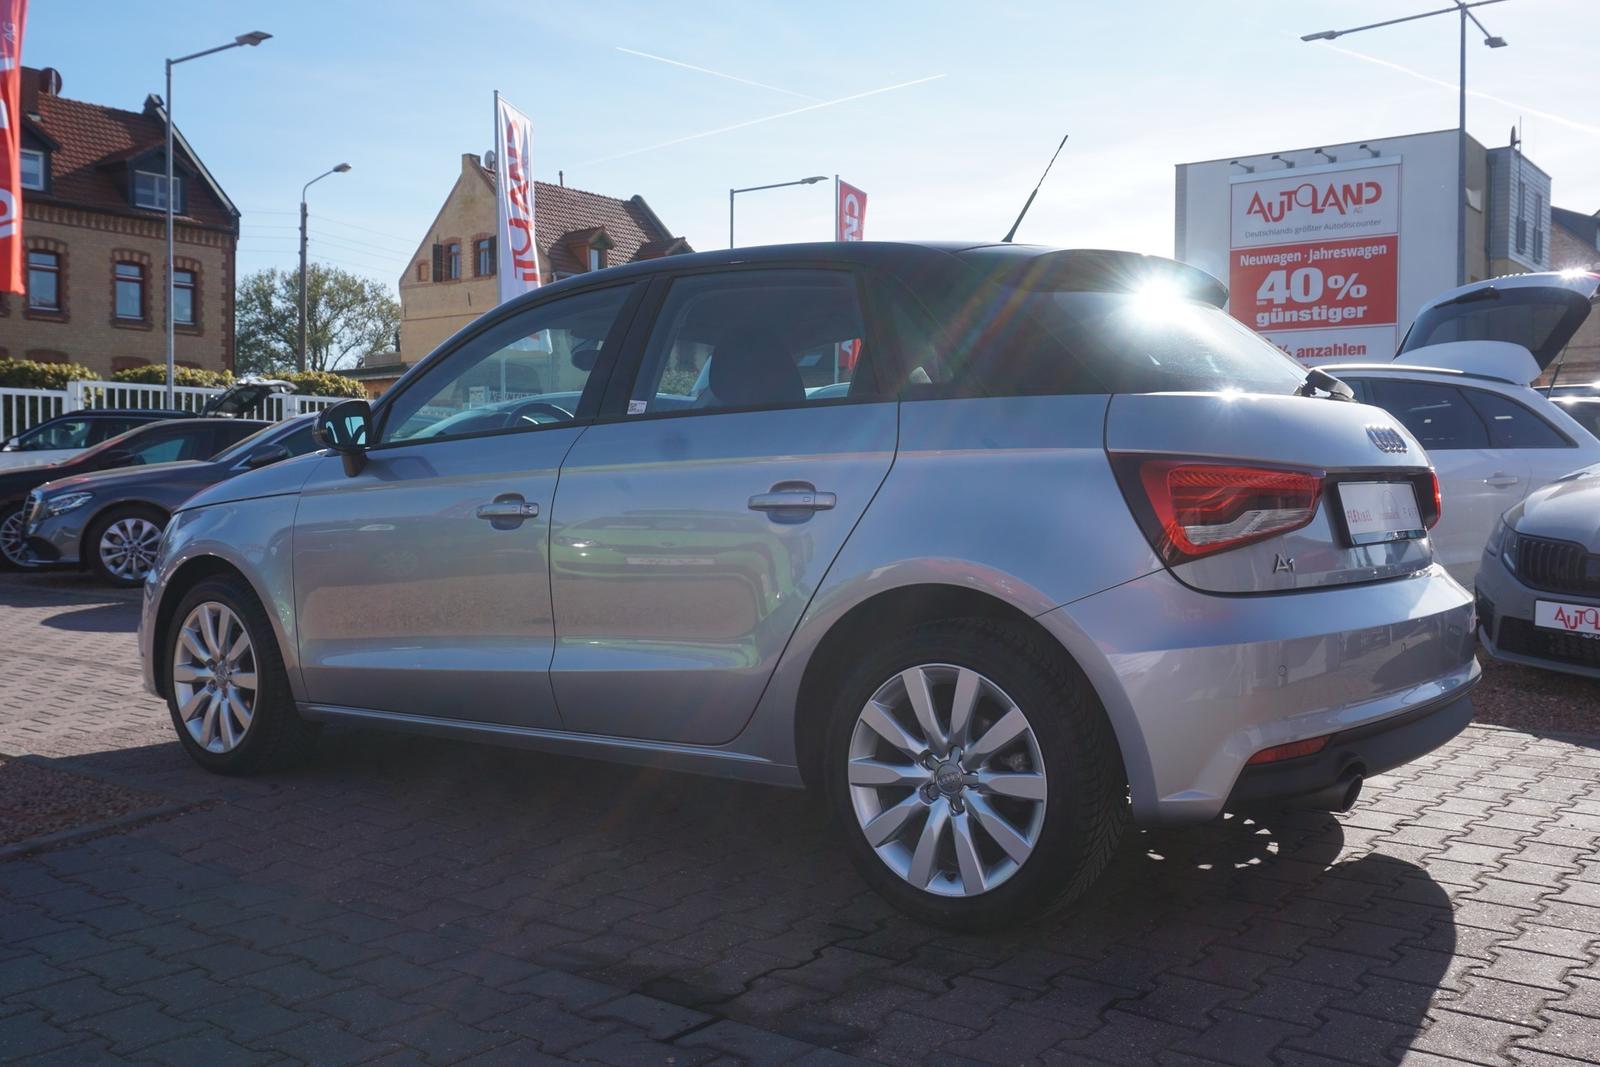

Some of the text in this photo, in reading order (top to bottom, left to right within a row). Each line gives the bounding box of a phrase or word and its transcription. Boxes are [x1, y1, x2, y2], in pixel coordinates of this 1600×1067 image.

[1246, 181, 1382, 223] AUTOLAND
[1244, 219, 1382, 239] Deutschlands größter Autodiscounter
[1240, 244, 1388, 267] Neuwagen Jahreswagen
[1256, 305, 1367, 327] günstiger
[1296, 343, 1367, 359] anzahlen
[1273, 553, 1296, 574] A1
